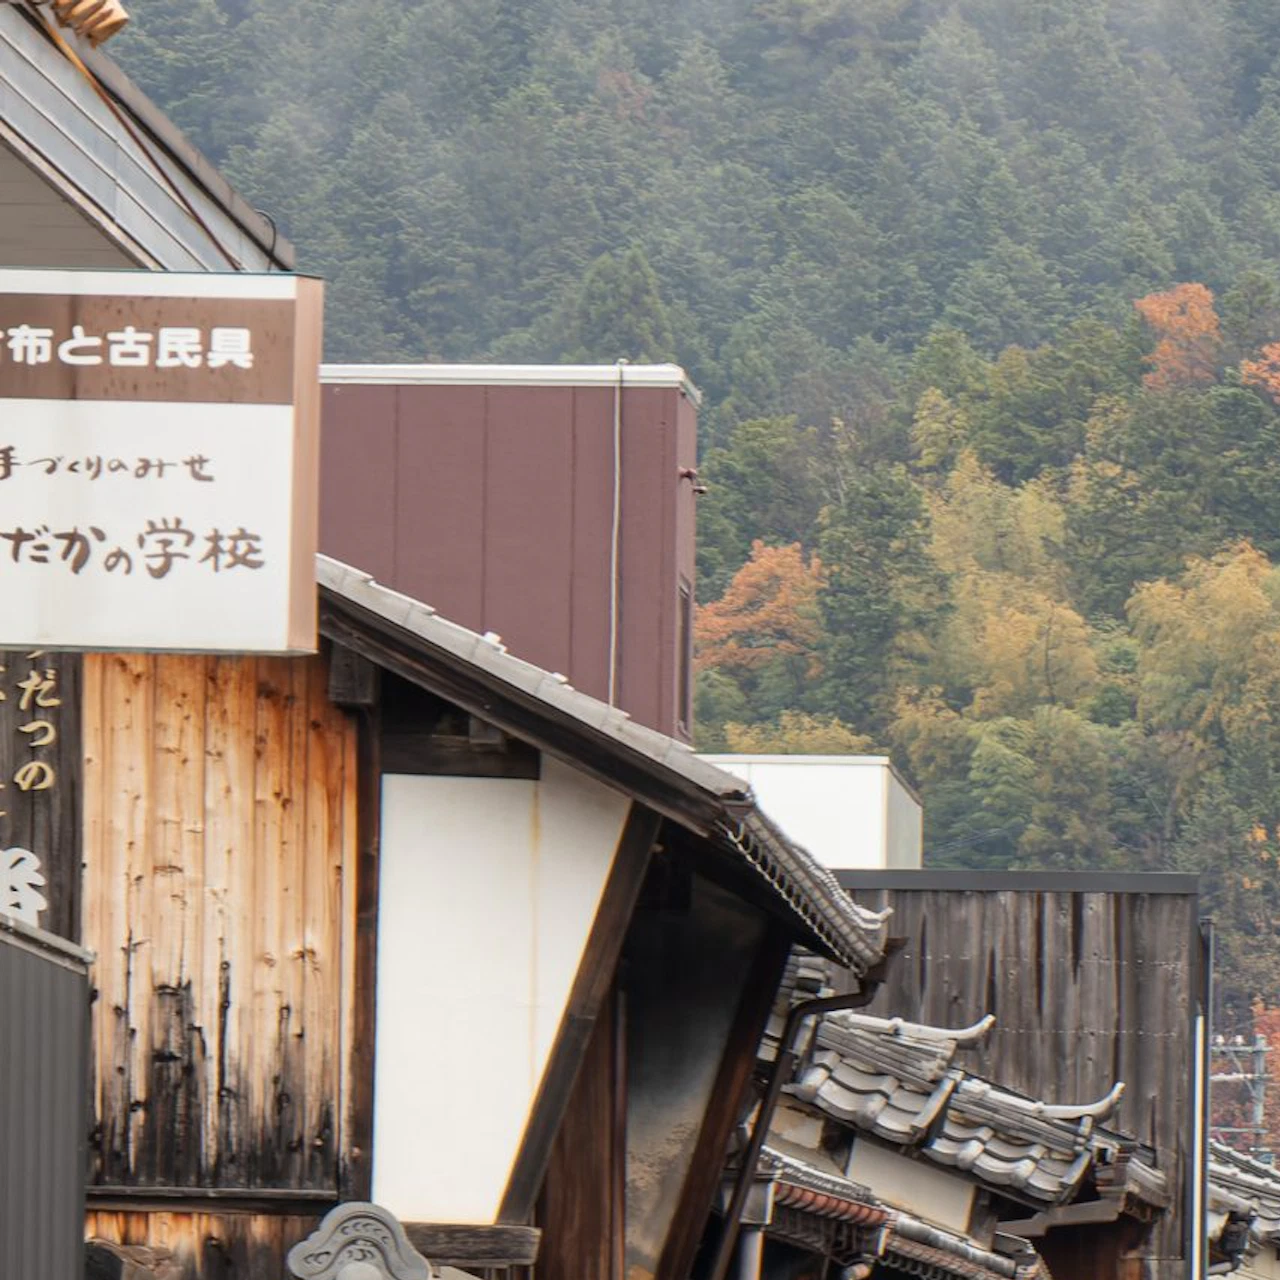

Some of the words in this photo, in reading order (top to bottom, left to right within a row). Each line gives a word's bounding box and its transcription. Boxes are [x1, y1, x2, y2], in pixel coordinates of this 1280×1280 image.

[0, 325, 254, 369] 布と古民具
[14, 650, 61, 791] だつの
